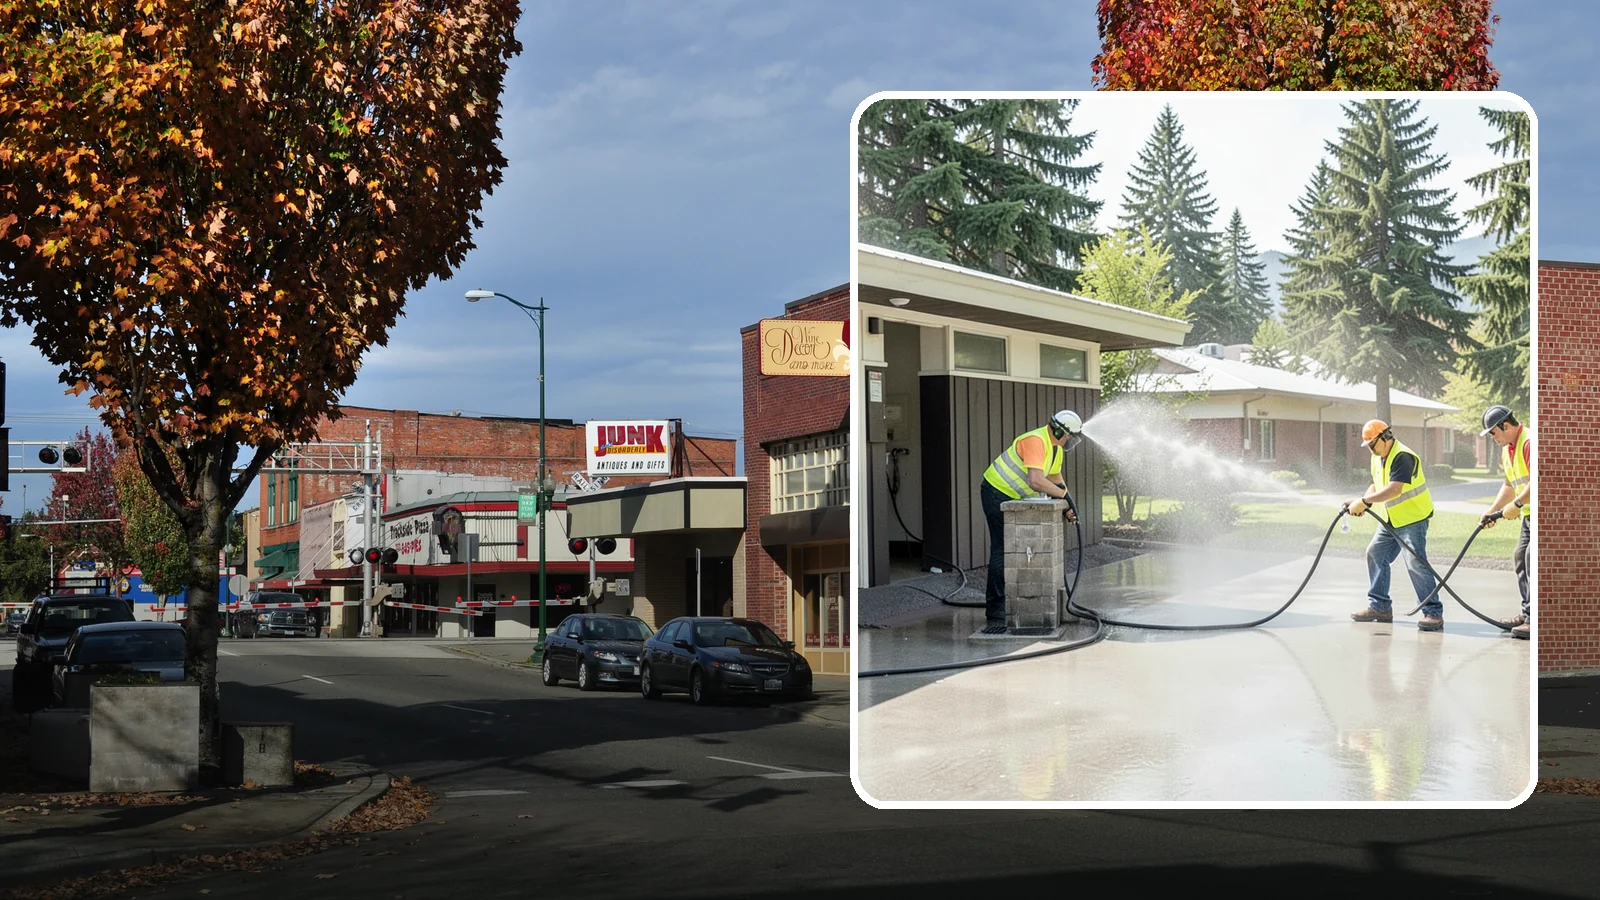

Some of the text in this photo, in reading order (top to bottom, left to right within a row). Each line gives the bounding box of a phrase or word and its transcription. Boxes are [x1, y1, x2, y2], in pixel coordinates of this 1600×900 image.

[596, 426, 664, 457] JUNK
[608, 446, 646, 454] DISORDERLY
[597, 460, 665, 470] ANTIQUES AND GIFTS
[353, 498, 365, 511] CRO
[414, 519, 429, 535] Pizza
